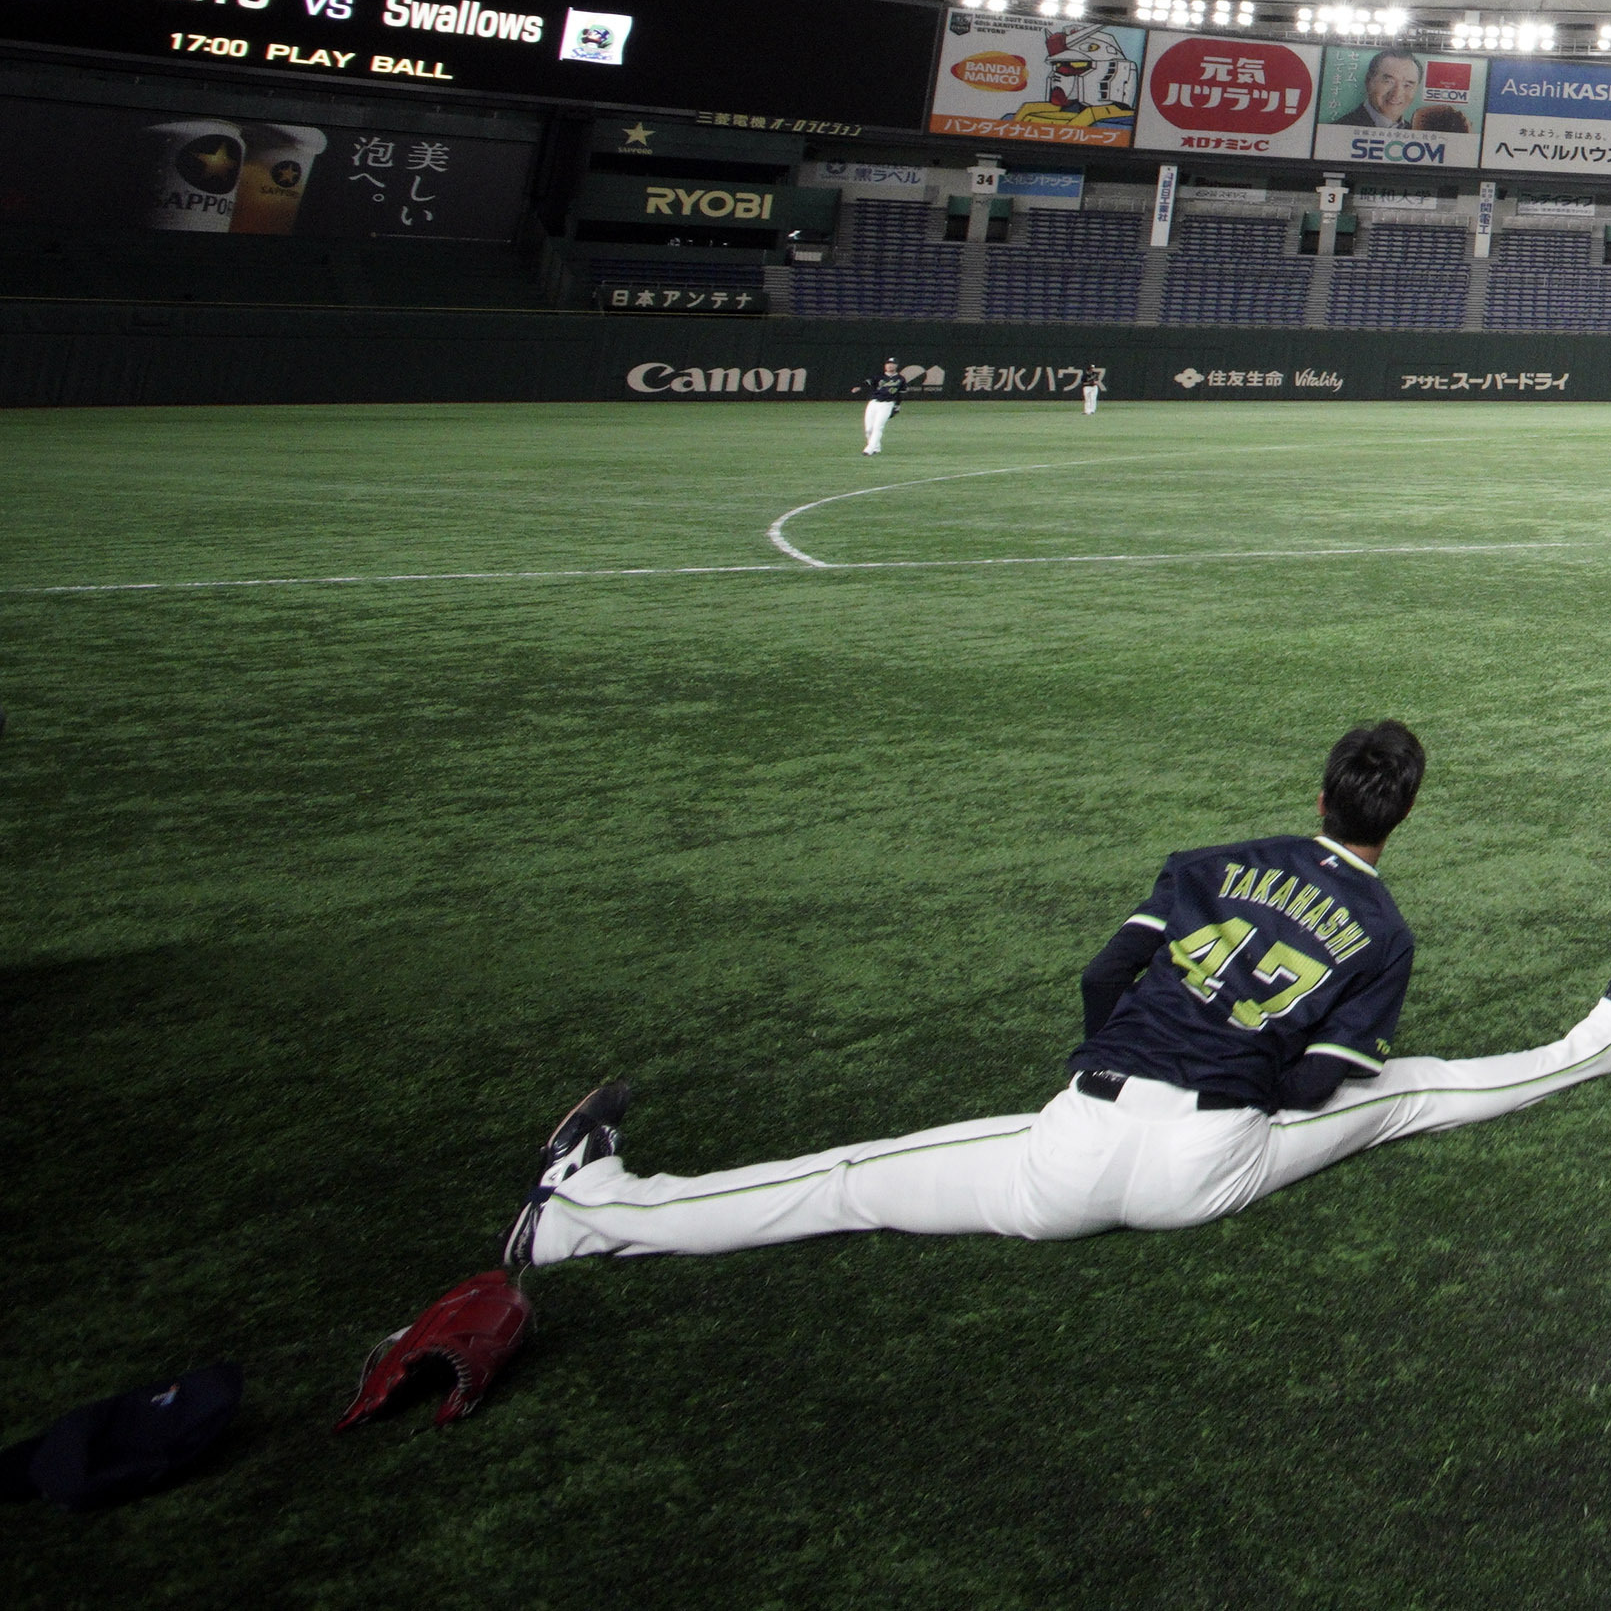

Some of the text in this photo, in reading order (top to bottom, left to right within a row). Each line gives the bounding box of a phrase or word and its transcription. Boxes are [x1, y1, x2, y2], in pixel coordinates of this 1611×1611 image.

[169, 32, 454, 80] 17:00 PLAY BALL
[964, 71, 1020, 85] NAMCO
[966, 61, 1021, 75] BANDAI
[1200, 55, 1266, 84] 元気
[1426, 90, 1468, 101] SECOM
[697, 110, 767, 128] 三菱電機
[617, 147, 653, 156] SAPPORO
[1180, 135, 1270, 152] オロナミンC
[1351, 138, 1445, 164] SECOM
[349, 136, 396, 204] 泡へ。
[855, 167, 921, 185] 黒ラベル
[977, 174, 994, 186] 34
[406, 141, 451, 226] 美しい
[646, 186, 773, 220] RYOBI
[1328, 193, 1336, 204] 3
[611, 289, 753, 309] 日本アンテナ
[627, 362, 807, 393] Canon
[1208, 369, 1344, 393] 住友生命 Vitality
[1400, 371, 1570, 392] アサヒスーパードライ
[1218, 863, 1371, 964] TAKAHASHI
[1169, 917, 1333, 1031] 47
